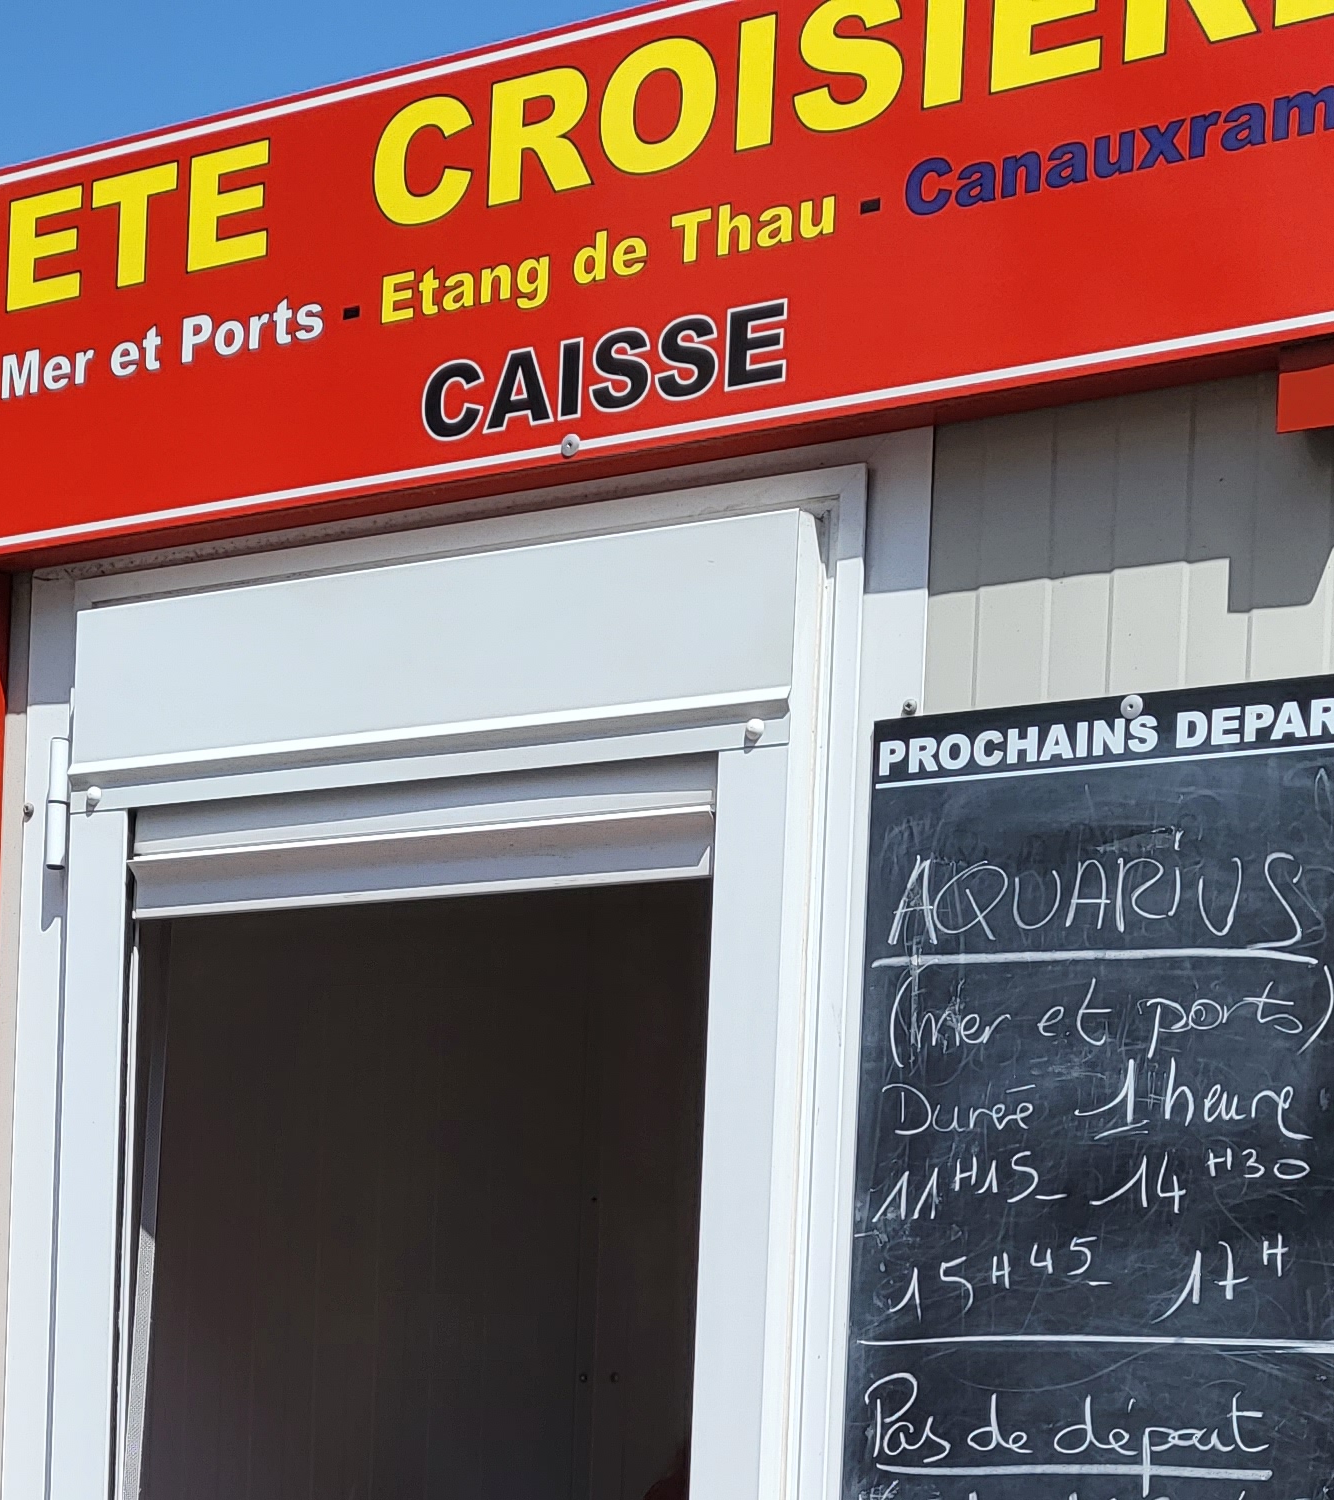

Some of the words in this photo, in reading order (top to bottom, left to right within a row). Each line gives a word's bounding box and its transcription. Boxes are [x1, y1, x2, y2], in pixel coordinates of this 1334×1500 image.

[1, 348, 94, 400] Mer
[110, 326, 161, 378] et
[181, 297, 325, 364] Ports
[380, 253, 550, 326] Etang
[572, 230, 649, 284] de
[671, 193, 836, 264] Thau
[423, 297, 788, 441] CAISSE
[878, 716, 1158, 776] PROCHAINS
[887, 851, 1305, 950] AQUARIUS
[888, 960, 1010, 1068] (mer
[1037, 978, 1113, 1046] et
[1138, 964, 1334, 1059] ports)
[1164, 1058, 1313, 1140] heure
[865, 1373, 951, 1462] Pas
[968, 1393, 1034, 1455] de
[1053, 1391, 1270, 1497] départ
